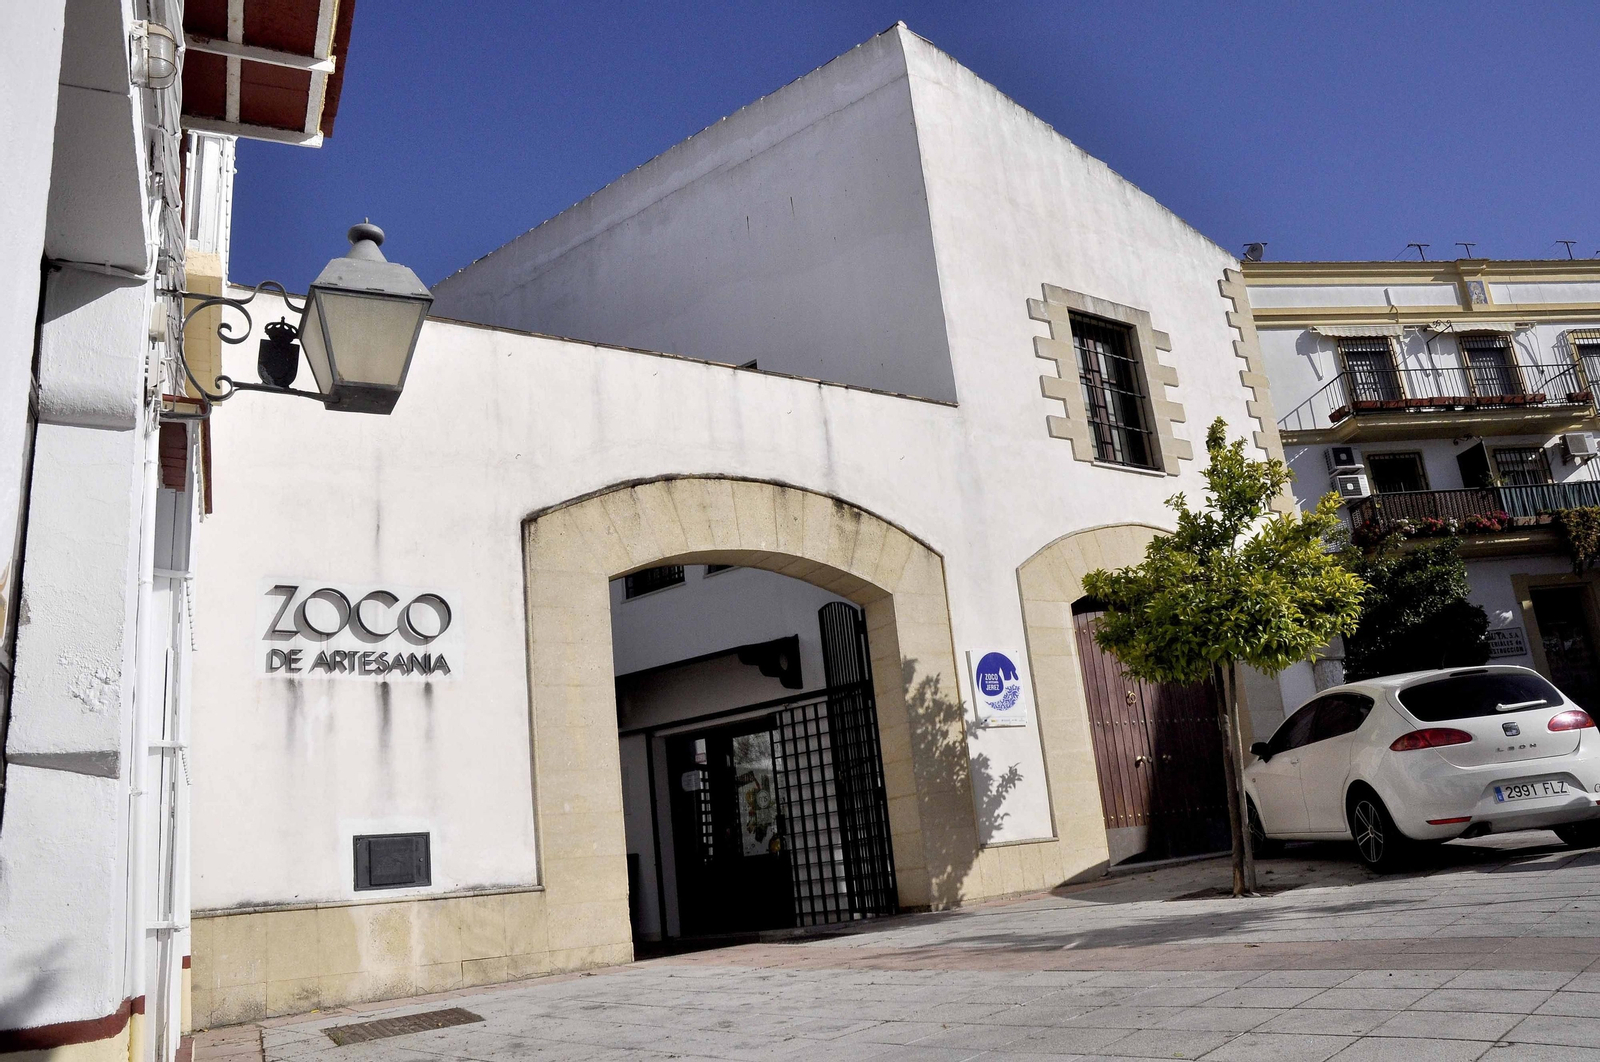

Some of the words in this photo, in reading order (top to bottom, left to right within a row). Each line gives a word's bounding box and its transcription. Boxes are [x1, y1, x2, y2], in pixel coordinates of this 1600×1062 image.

[263, 584, 452, 644] ZOCO
[1490, 640, 1513, 648] ERIALES
[266, 649, 304, 674] DE
[309, 649, 452, 677] ARTESANIA
[1505, 783, 1538, 799] 2991
[1542, 781, 1568, 795] FLZ
